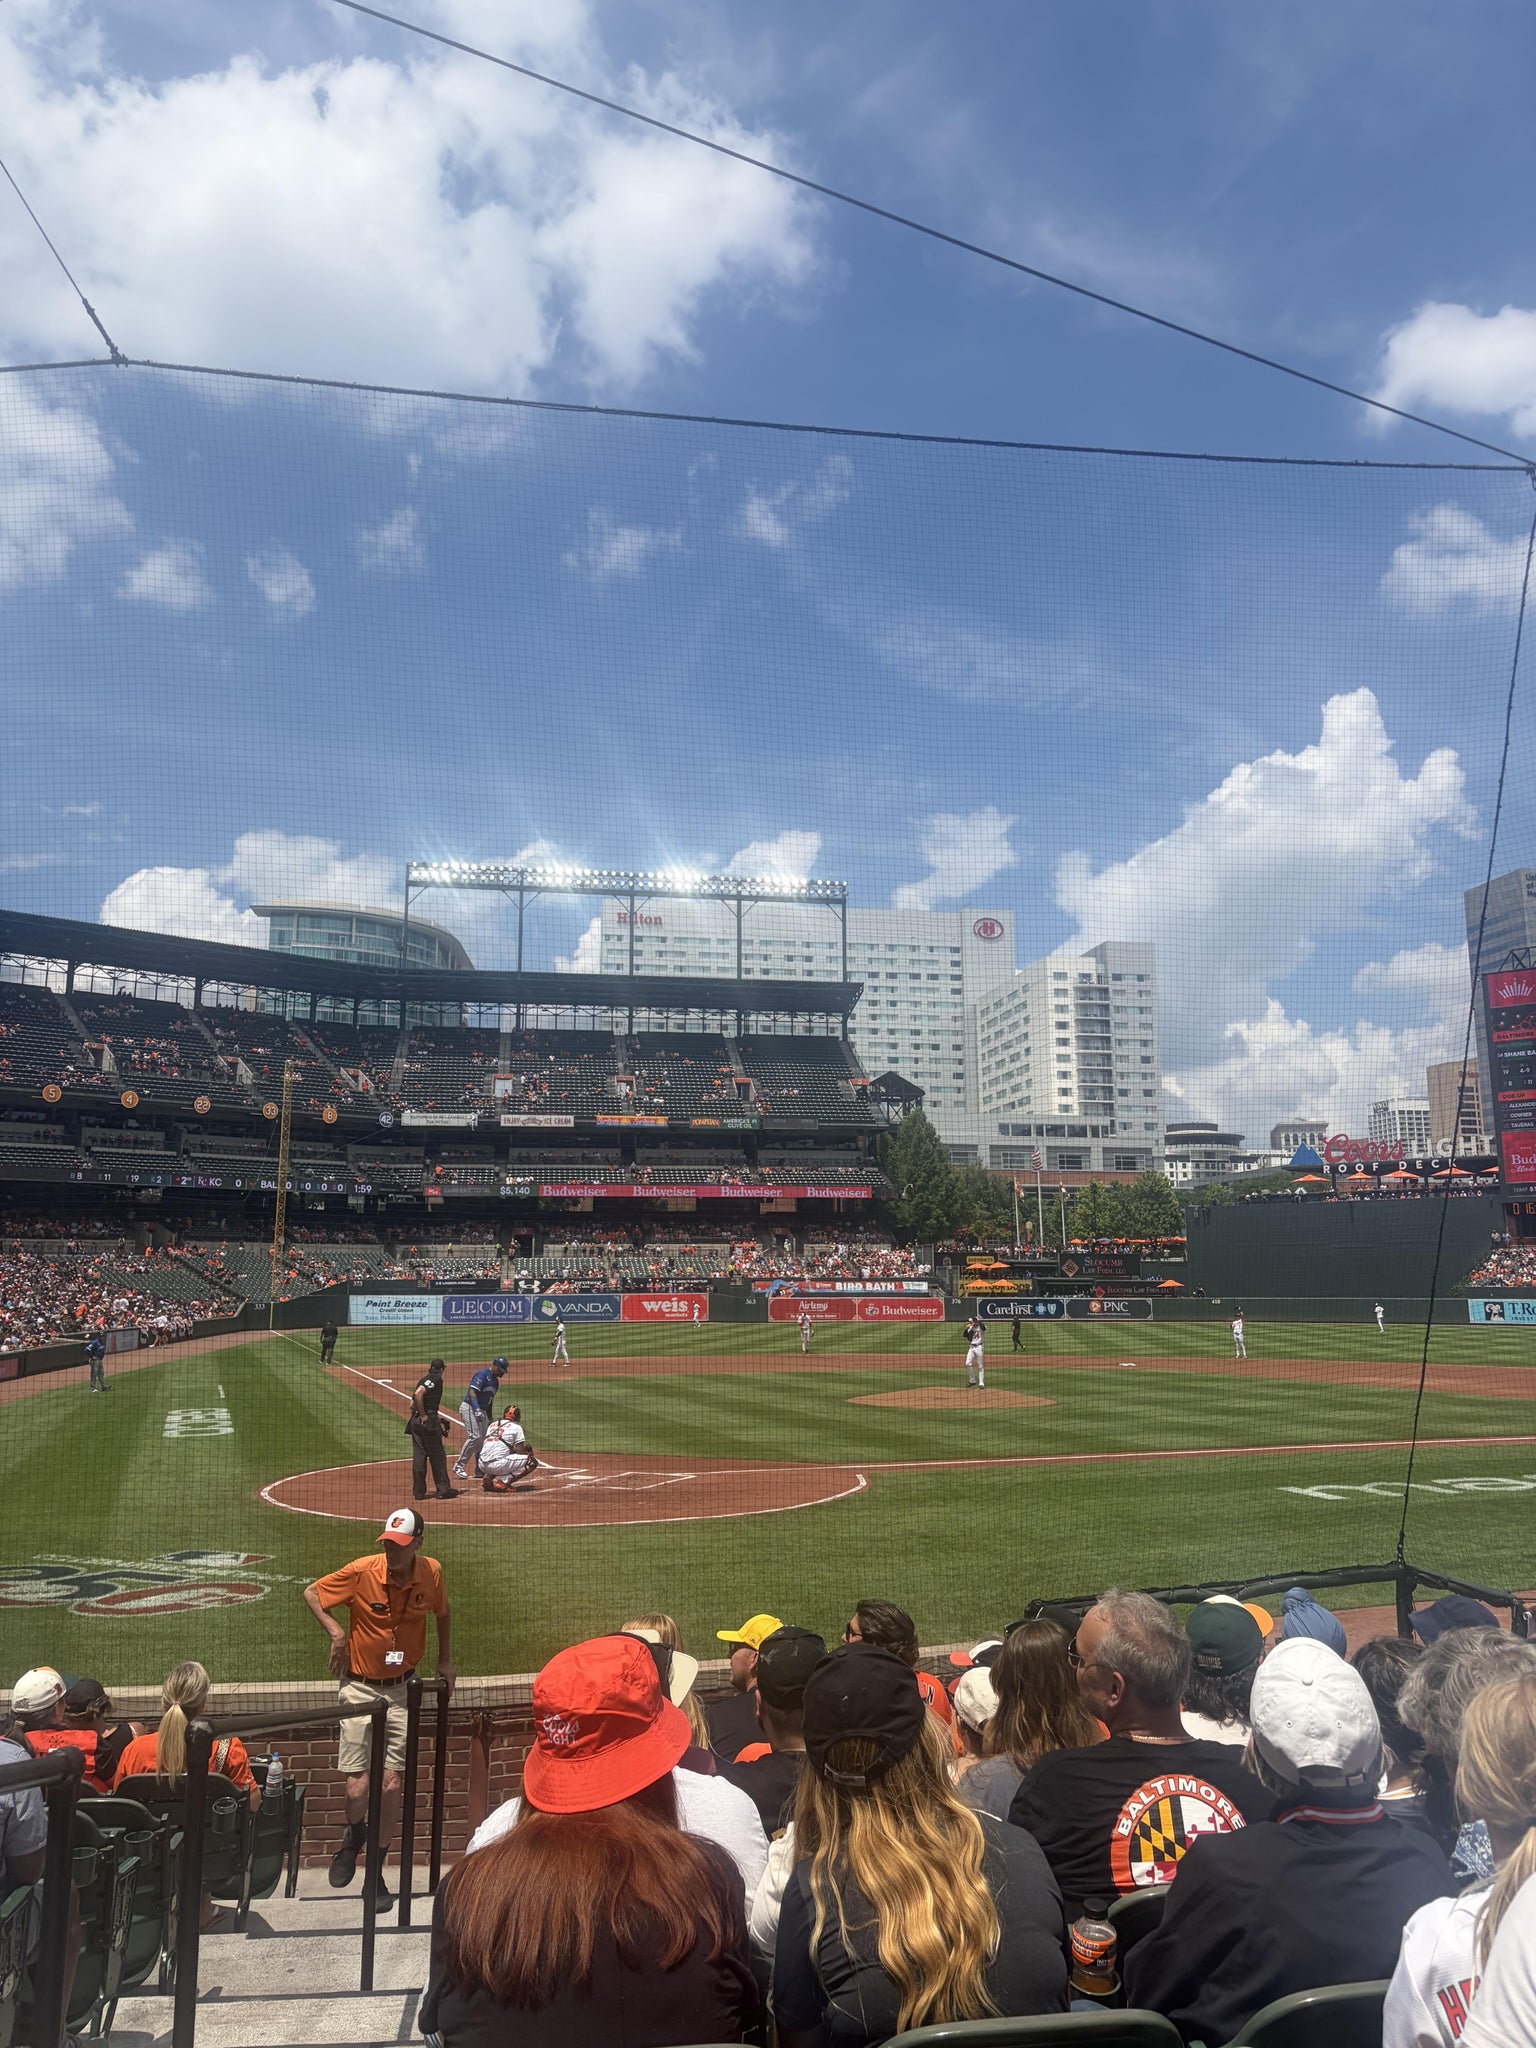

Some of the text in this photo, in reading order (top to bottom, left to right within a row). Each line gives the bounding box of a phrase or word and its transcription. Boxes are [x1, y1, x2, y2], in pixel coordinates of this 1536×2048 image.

[617, 912, 663, 925] Hlton
[48, 1087, 57, 1099] 5
[126, 1093, 134, 1105] 4
[196, 1100, 209, 1110] 22
[265, 1106, 277, 1116] 33
[327, 1110, 333, 1121] 8
[380, 1114, 392, 1125] 42
[1322, 1133, 1494, 1164] Coors LIGHT
[1323, 1160, 1457, 1178] ROOF DECK
[77, 1172, 83, 1180] 8
[104, 1173, 111, 1181] 11
[131, 1174, 139, 1183] 19
[157, 1175, 162, 1184] 2
[209, 1178, 222, 1187] KC
[260, 1180, 278, 1189] BAL
[354, 1184, 372, 1193] 1:59
[1085, 1257, 1123, 1267] SLOCUMB
[836, 1282, 864, 1290] BIRD
[866, 1282, 895, 1291] BATH
[394, 1300, 428, 1308] Breeze
[451, 1300, 524, 1315] LECOM
[558, 1303, 613, 1313] VANDA
[641, 1297, 689, 1313] weis
[799, 1301, 829, 1312] Airtemp
[987, 1302, 1034, 1315] CareFirst
[1103, 1302, 1129, 1312] PNC
[542, 1713, 579, 1735] Coors
[1117, 1777, 1245, 1837] BALTIMORE
